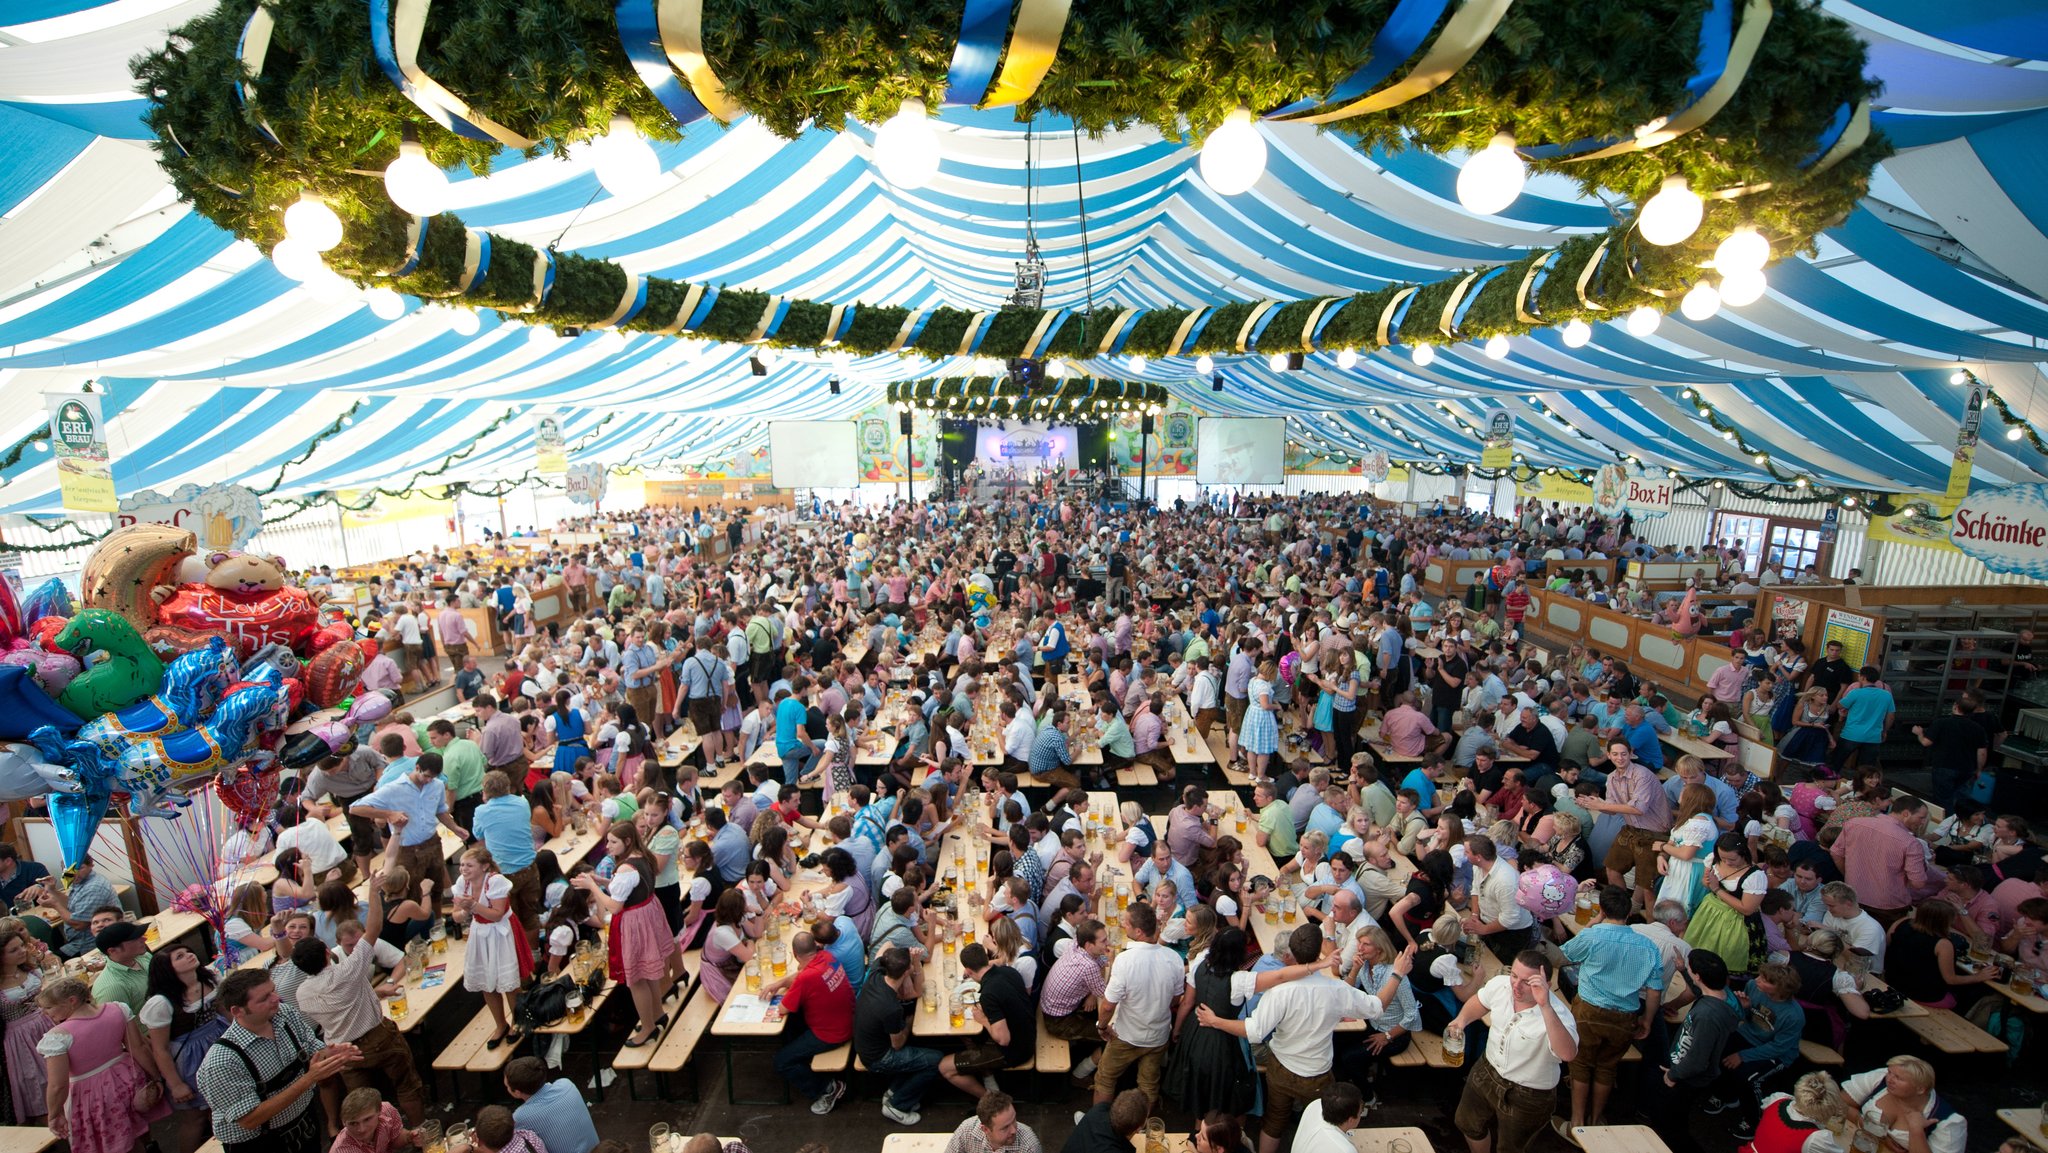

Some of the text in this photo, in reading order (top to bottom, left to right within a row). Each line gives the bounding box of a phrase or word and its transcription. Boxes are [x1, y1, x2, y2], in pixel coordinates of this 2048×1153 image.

[61, 421, 93, 435] ERL
[567, 476, 588, 492] Box D
[1628, 481, 1670, 506] Box H
[1953, 509, 2047, 547] Schänke
[191, 593, 310, 618] I Love You
[205, 616, 291, 651] This
